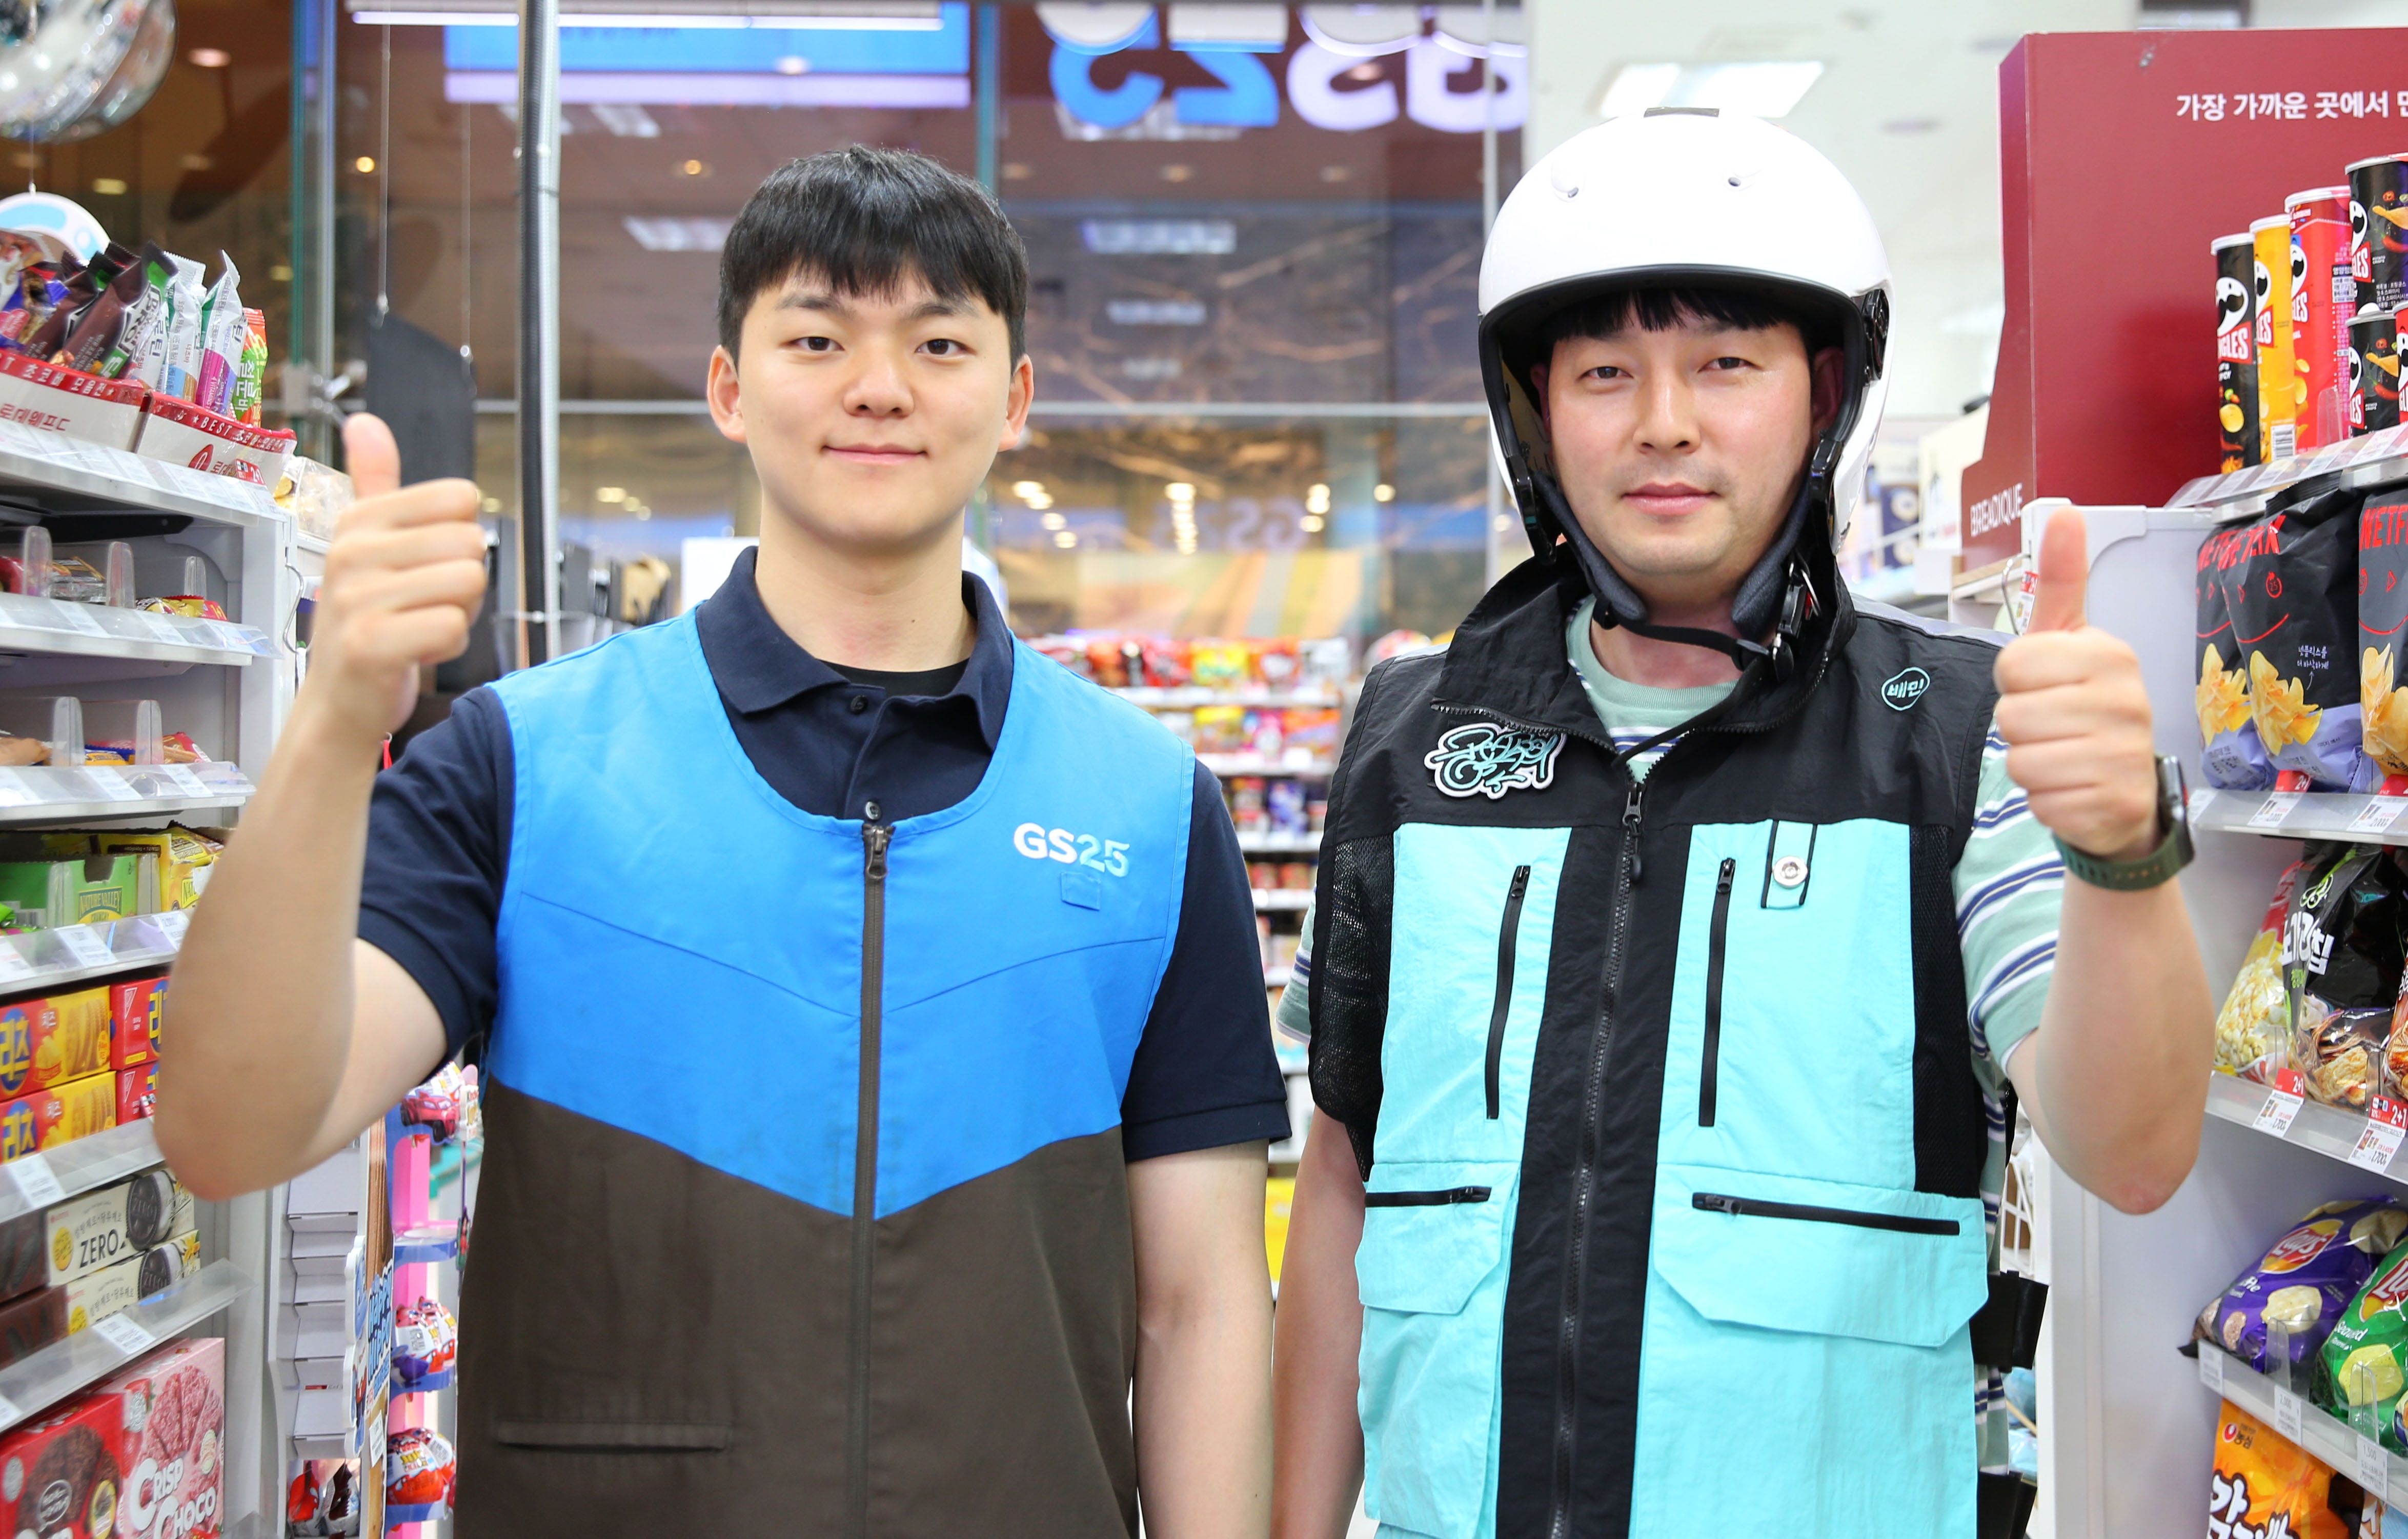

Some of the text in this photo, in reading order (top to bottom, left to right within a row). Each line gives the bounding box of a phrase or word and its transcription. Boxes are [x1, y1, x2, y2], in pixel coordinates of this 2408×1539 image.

[2176, 93, 2227, 121] 가장
[2233, 92, 2308, 121] 가까운
[2314, 90, 2390, 119] 곳에서
[22, 363, 67, 387] 초코바
[70, 377, 107, 397] 모음전
[235, 361, 255, 412] 철분바
[200, 416, 233, 436] BEST
[1970, 483, 2023, 537] BREADIQUE
[2298, 645, 2328, 659] 넷플릭스를
[1887, 678, 1925, 698] 배민
[1013, 822, 1130, 877] GS25
[2292, 1075, 2304, 1095] 2+1
[2390, 1104, 2407, 1128] 2+1
[80, 1229, 119, 1269] ZERO
[2272, 1229, 2328, 1260] Lay's
[130, 1456, 184, 1531] CRISP
[154, 1486, 216, 1539] CHOCO
